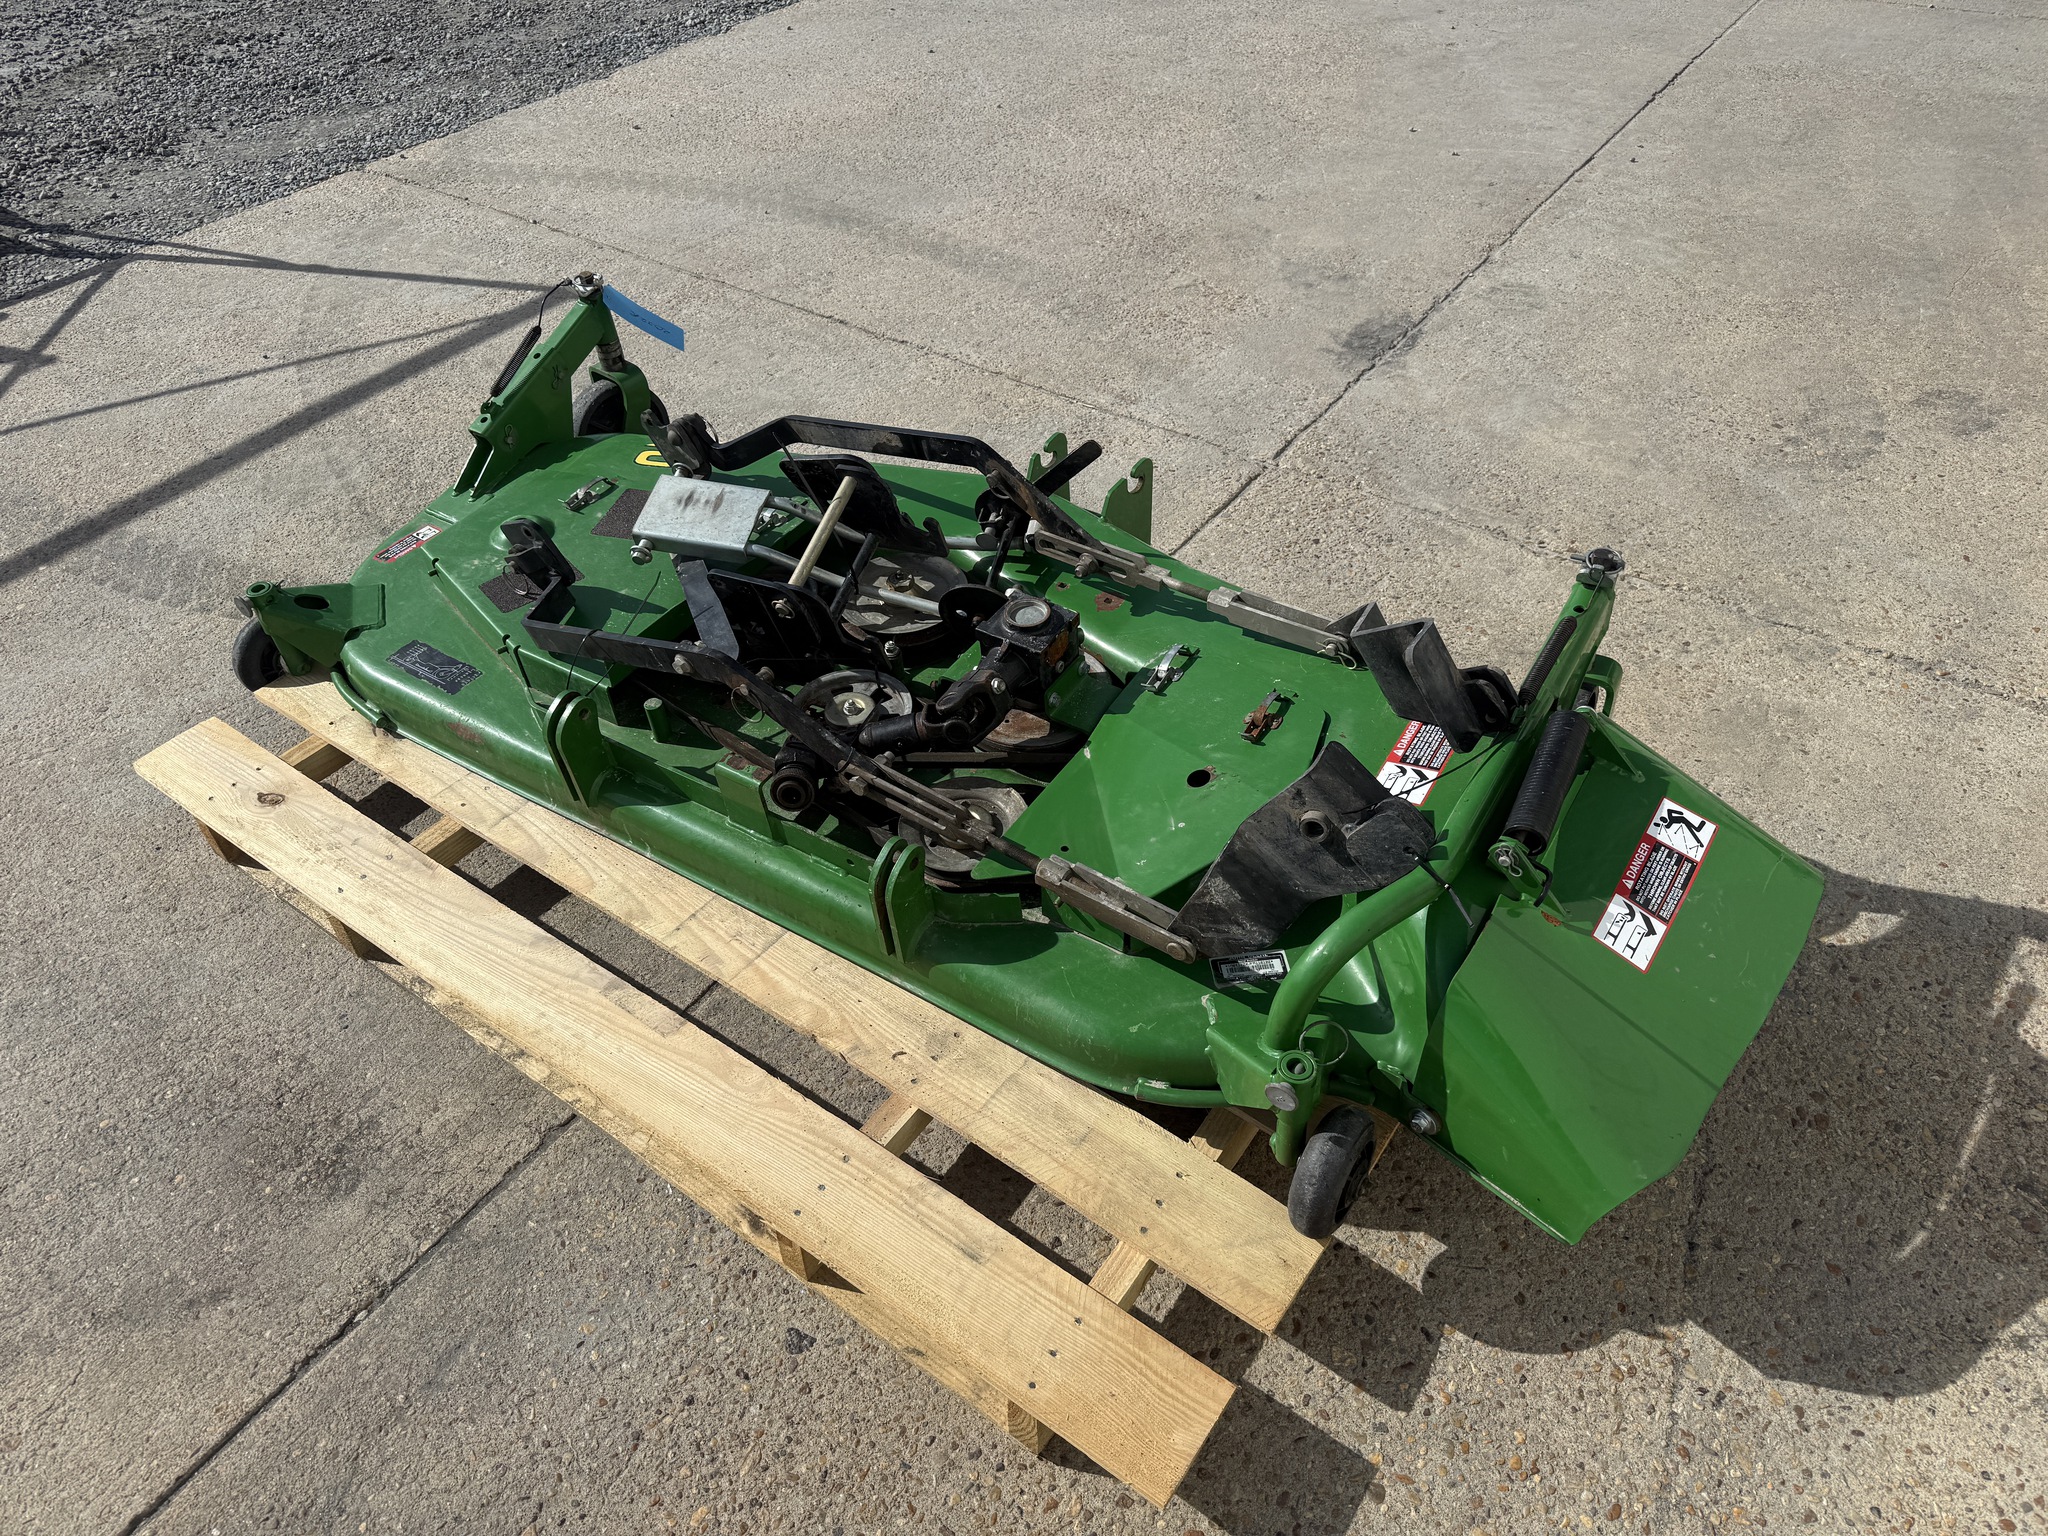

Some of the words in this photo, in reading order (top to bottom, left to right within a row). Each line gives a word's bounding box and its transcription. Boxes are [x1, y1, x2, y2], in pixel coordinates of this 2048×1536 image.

[1396, 720, 1419, 748] DANGER
[1626, 841, 1650, 879] DANGER
[1634, 866, 1649, 890] ROTATING
[1646, 850, 1656, 867] BLADE
[1647, 877, 1660, 899] THROWN
[1657, 857, 1670, 878] OBJECTS
